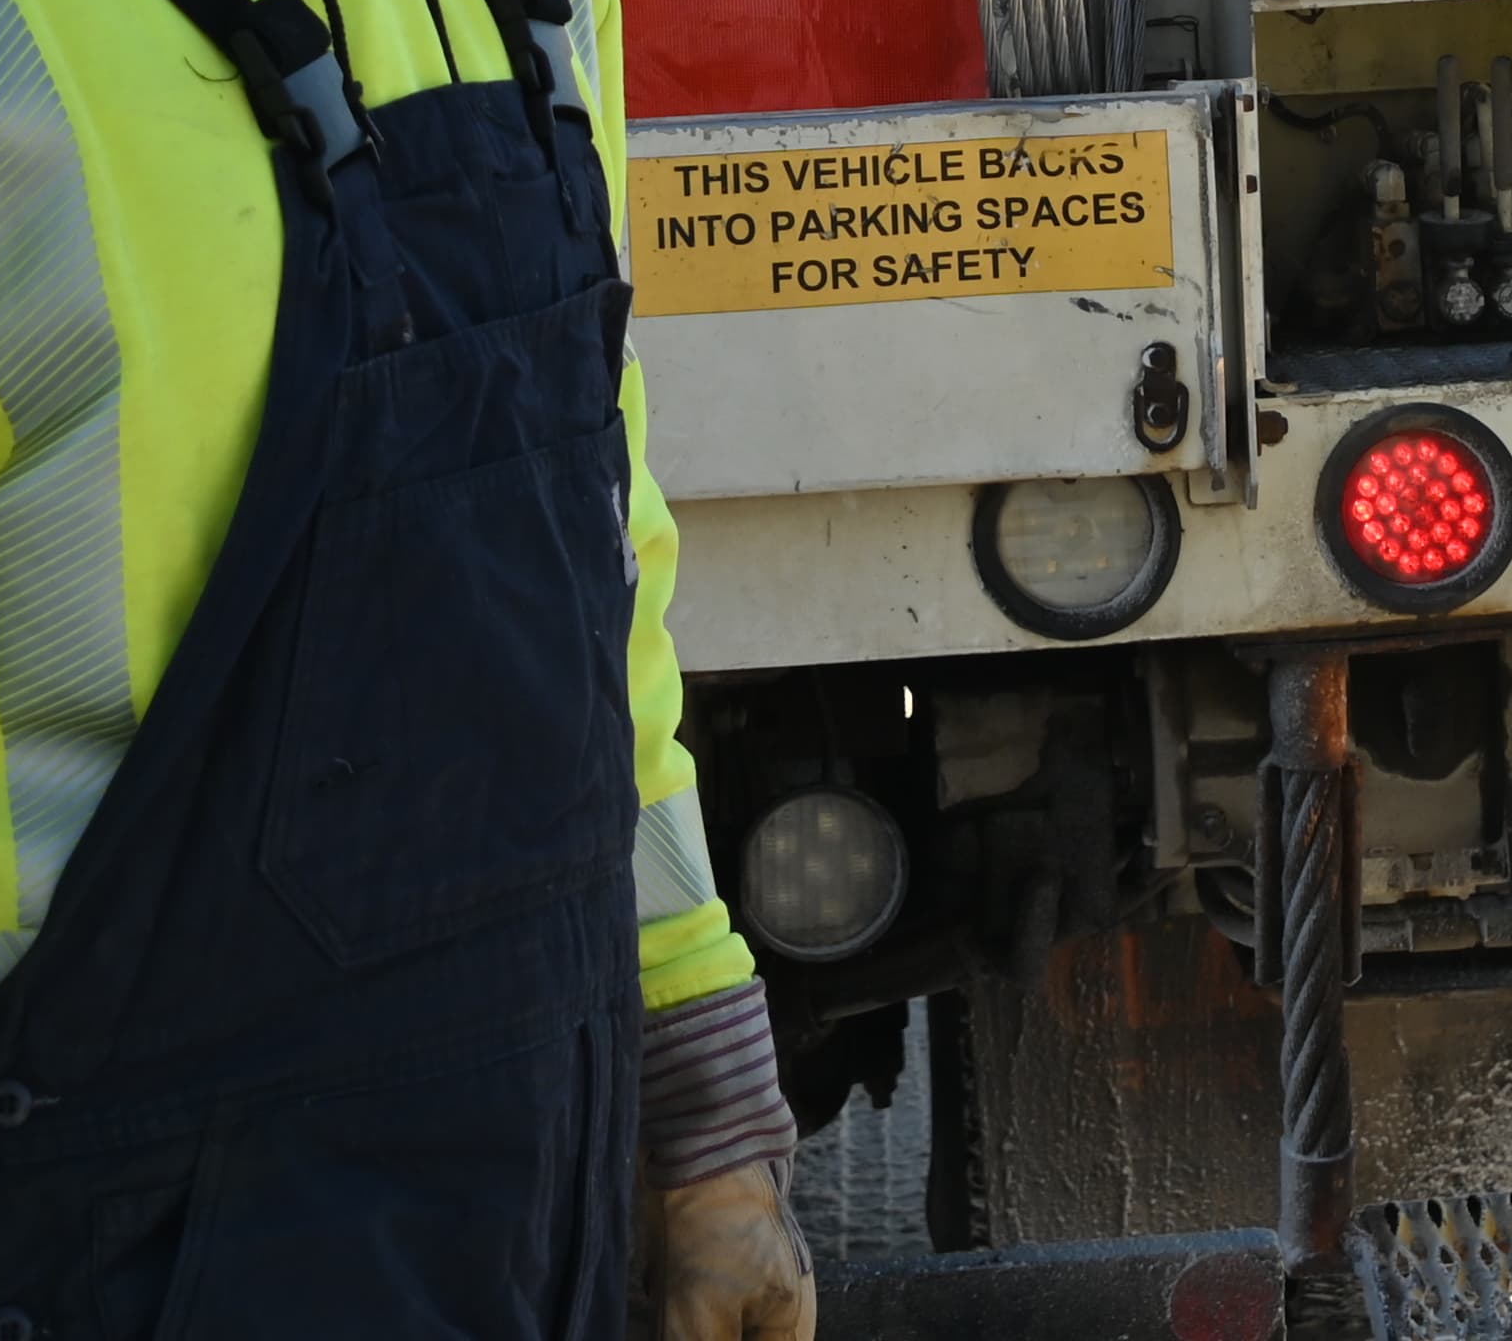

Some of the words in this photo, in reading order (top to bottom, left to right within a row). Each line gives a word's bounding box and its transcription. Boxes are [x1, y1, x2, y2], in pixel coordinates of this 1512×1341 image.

[673, 161, 770, 197] THIS
[782, 150, 965, 191] VEHICLE
[978, 143, 1124, 179] BACKS
[657, 213, 756, 249] INTO
[770, 200, 962, 243] PARKING
[976, 191, 1145, 230] SPACES
[771, 258, 859, 294] FOR
[872, 246, 1035, 288] SAFETY
